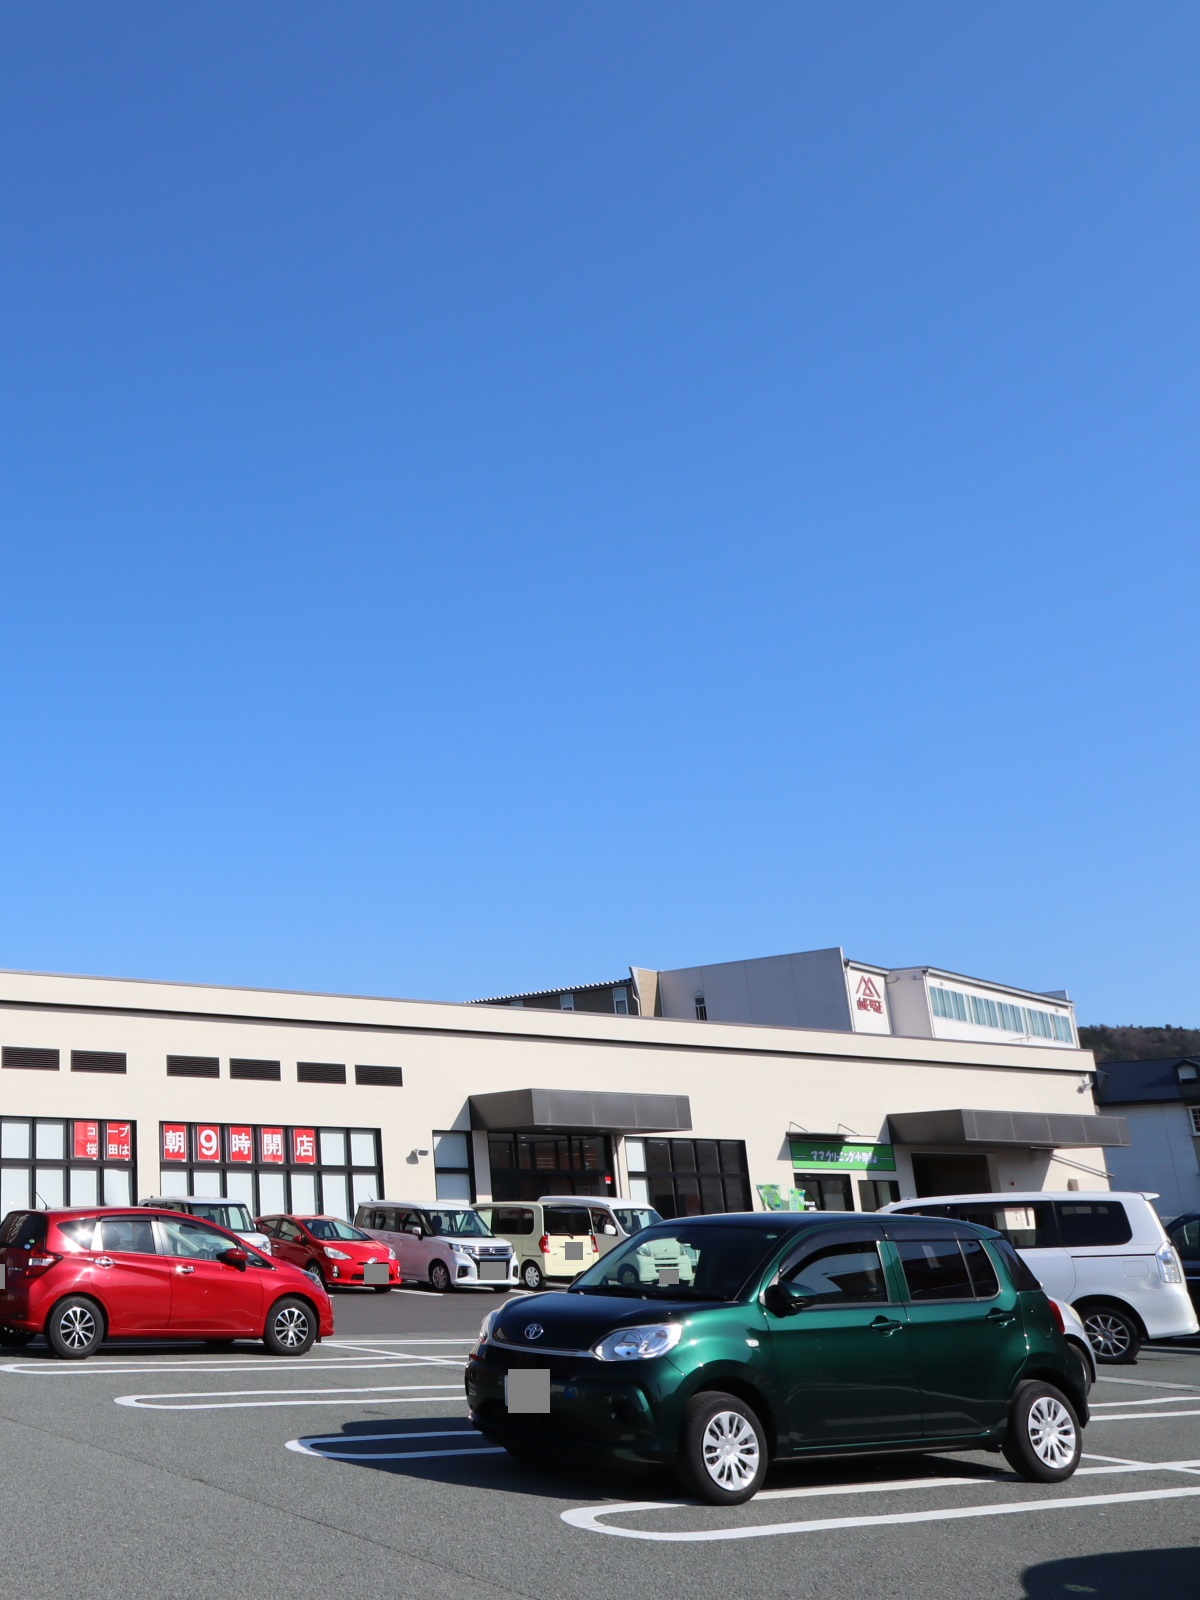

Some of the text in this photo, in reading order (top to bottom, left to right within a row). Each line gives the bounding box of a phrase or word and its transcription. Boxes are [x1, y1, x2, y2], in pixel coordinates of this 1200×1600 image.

[87, 1125, 129, 1137] コープ
[86, 1142, 130, 1156] 桜田は
[165, 1129, 314, 1157] 朝9時開店
